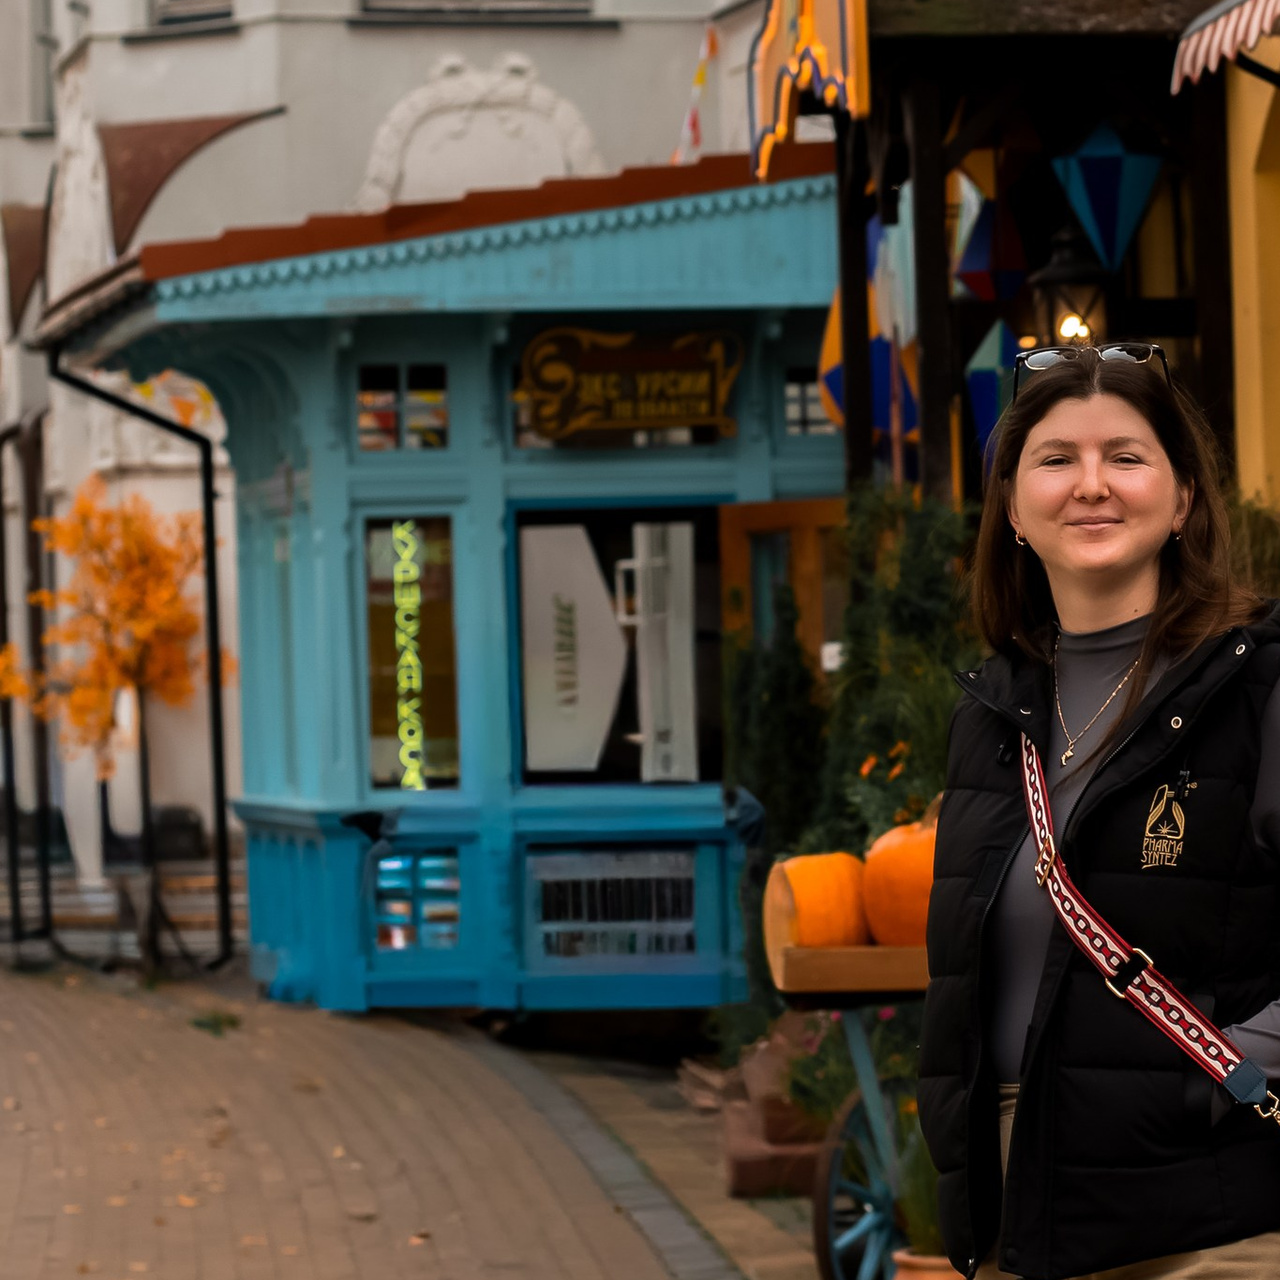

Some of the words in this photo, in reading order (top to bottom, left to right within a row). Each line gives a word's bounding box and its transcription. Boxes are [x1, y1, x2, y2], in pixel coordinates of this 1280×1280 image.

[577, 371, 710, 402] ЭКСУРСИИ
[397, 696, 427, 790] КОСА
[1143, 838, 1183, 854] PHARMA
[1141, 851, 1178, 869] SYNTEZ
